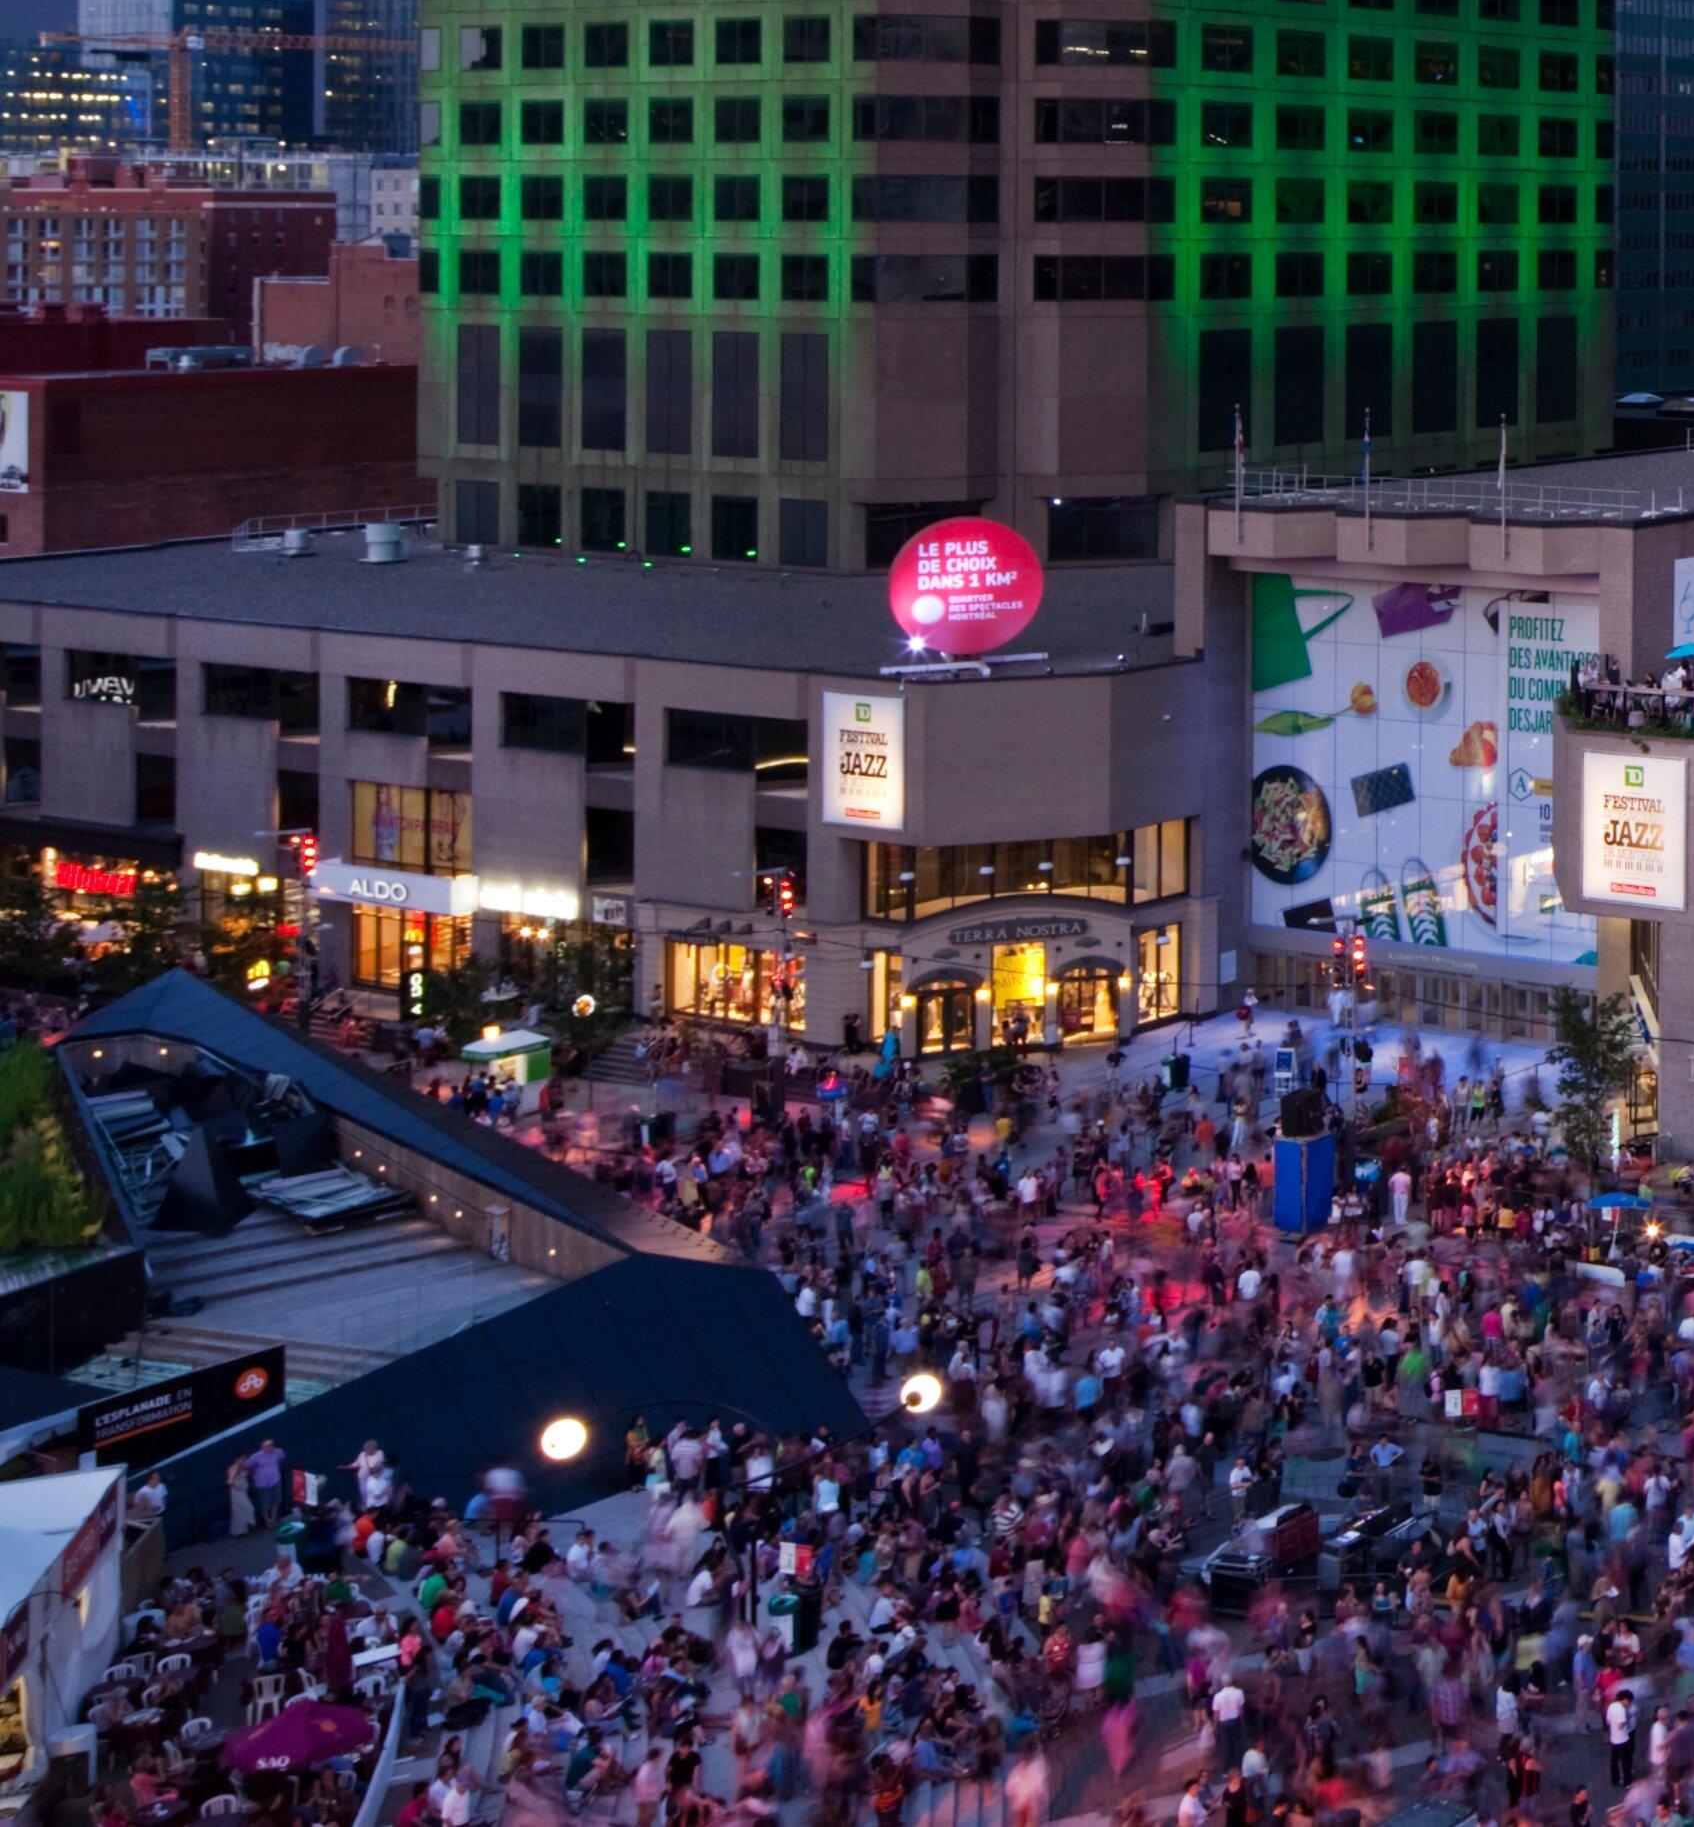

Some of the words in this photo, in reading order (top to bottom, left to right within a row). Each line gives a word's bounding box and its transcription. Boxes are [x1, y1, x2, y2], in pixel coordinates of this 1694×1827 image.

[918, 543, 939, 557] LE
[945, 540, 989, 556] PLUS
[918, 559, 941, 574] DE
[946, 556, 997, 572] CHOIX
[917, 575, 964, 590] DANS
[969, 574, 980, 588] 1
[968, 601, 1023, 612] SPECTACLES
[1508, 616, 1564, 642] PROFITEZ
[1509, 647, 1531, 669] DES
[1509, 676, 1526, 699] DU
[839, 729, 888, 745] FESTIVAL
[840, 752, 888, 778] JAZZ
[1626, 767, 1643, 786] TD
[1604, 794, 1665, 814] FESTIVAL
[1604, 820, 1665, 851] JAZZ
[348, 878, 408, 902] ALDO
[953, 929, 1008, 943] TERRA
[1016, 922, 1082, 938] NOSTRA
[410, 973, 423, 1015] ADO
[95, 1393, 171, 1427] L'ESPLANADE
[95, 1401, 192, 1440] TRANSFORMATION
